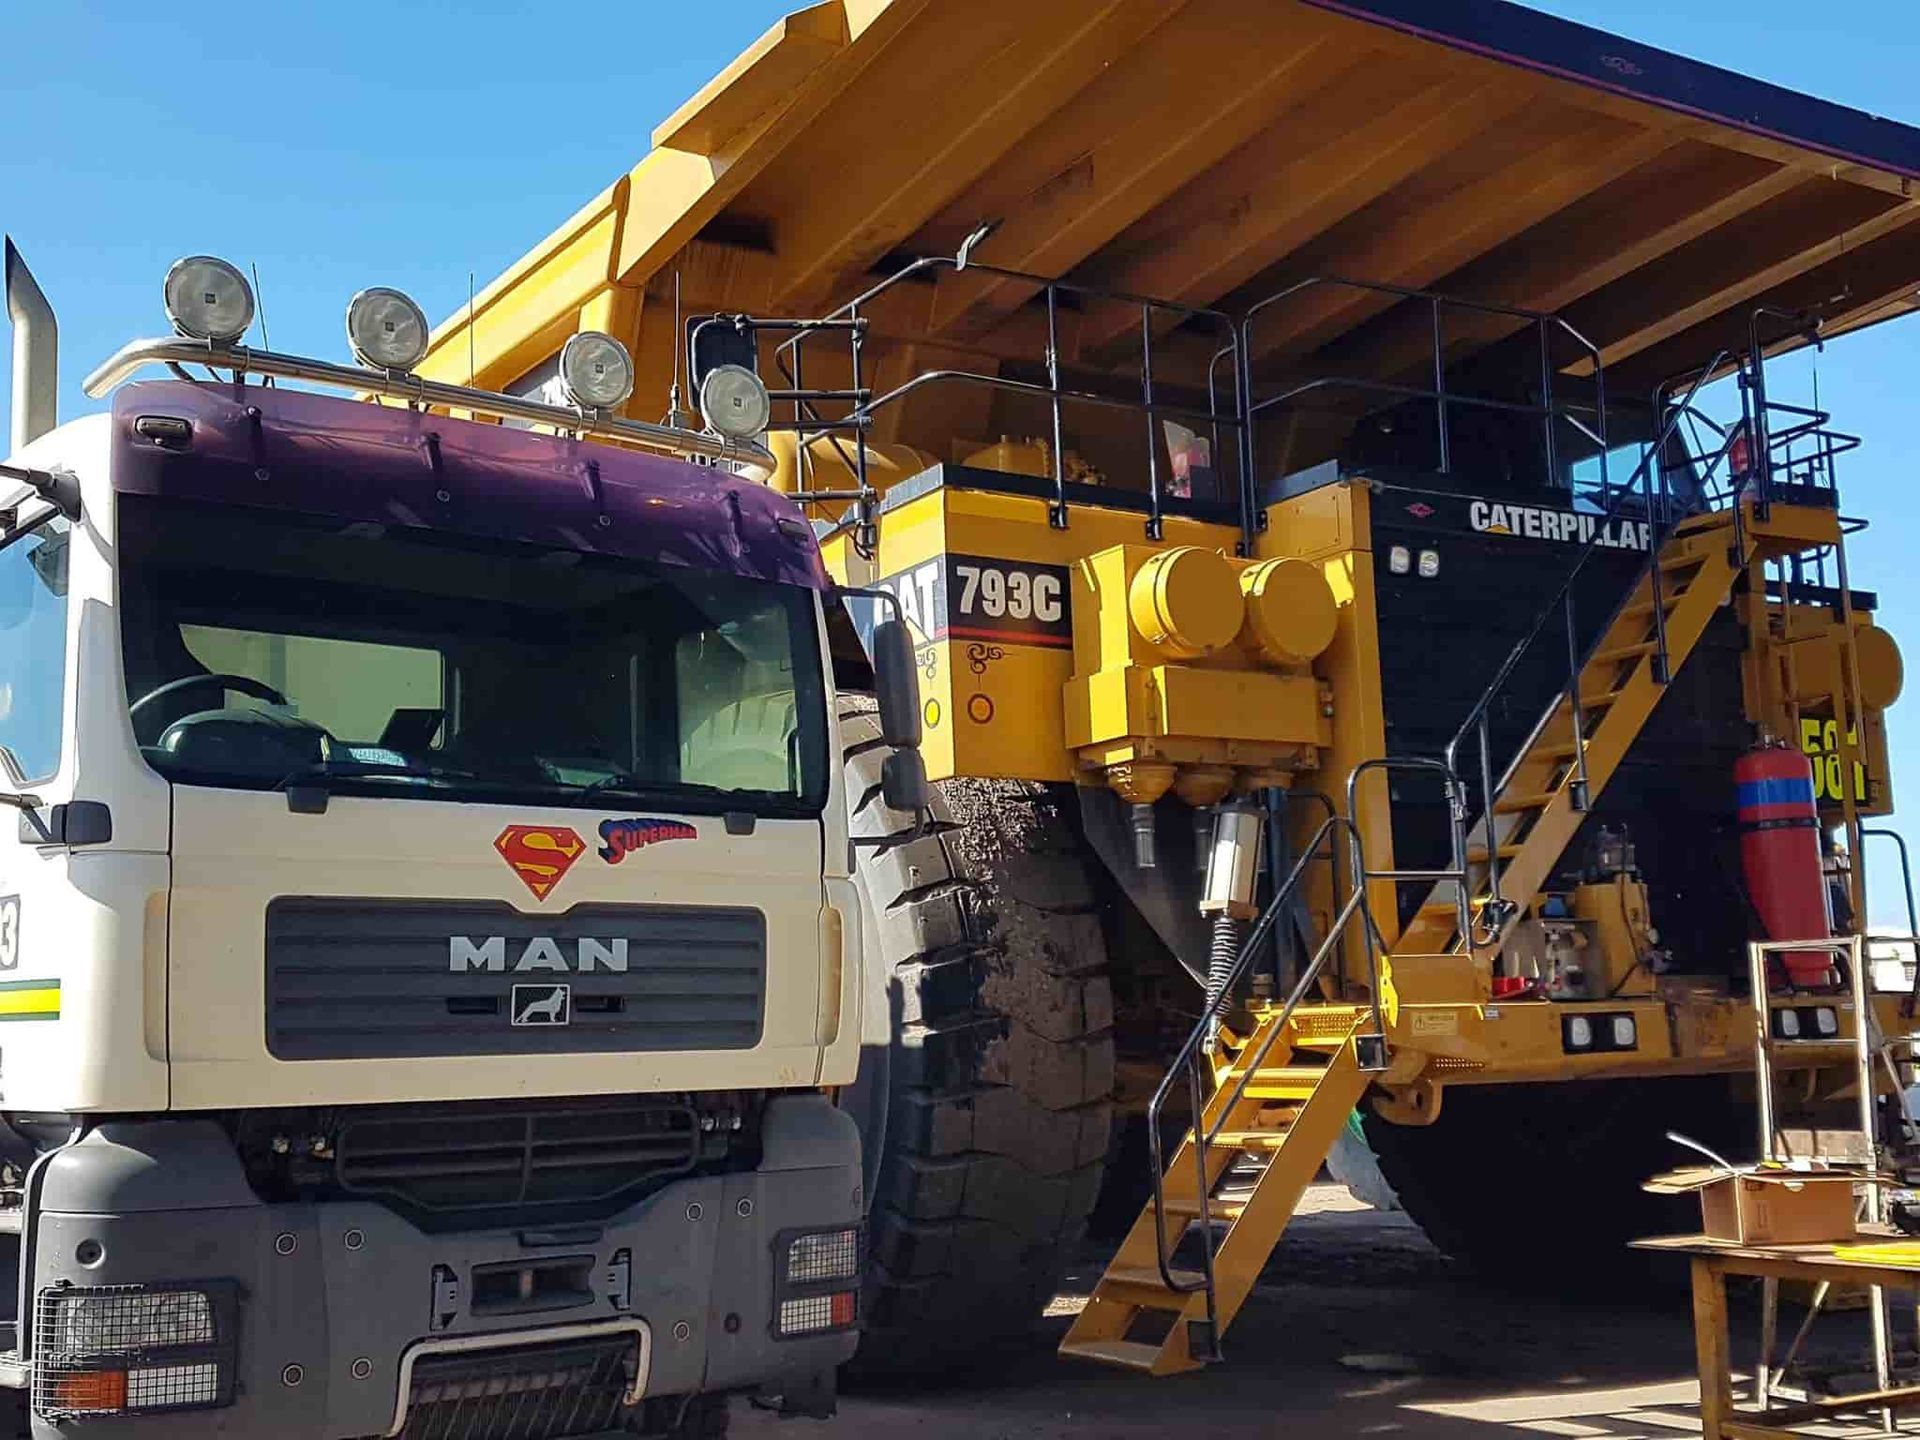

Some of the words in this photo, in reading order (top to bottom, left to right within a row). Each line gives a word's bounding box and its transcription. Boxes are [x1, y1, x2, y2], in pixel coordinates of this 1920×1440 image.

[956, 566, 1062, 622] 793C
[600, 819, 697, 864] SUPERMAN
[450, 936, 628, 971] MAN
